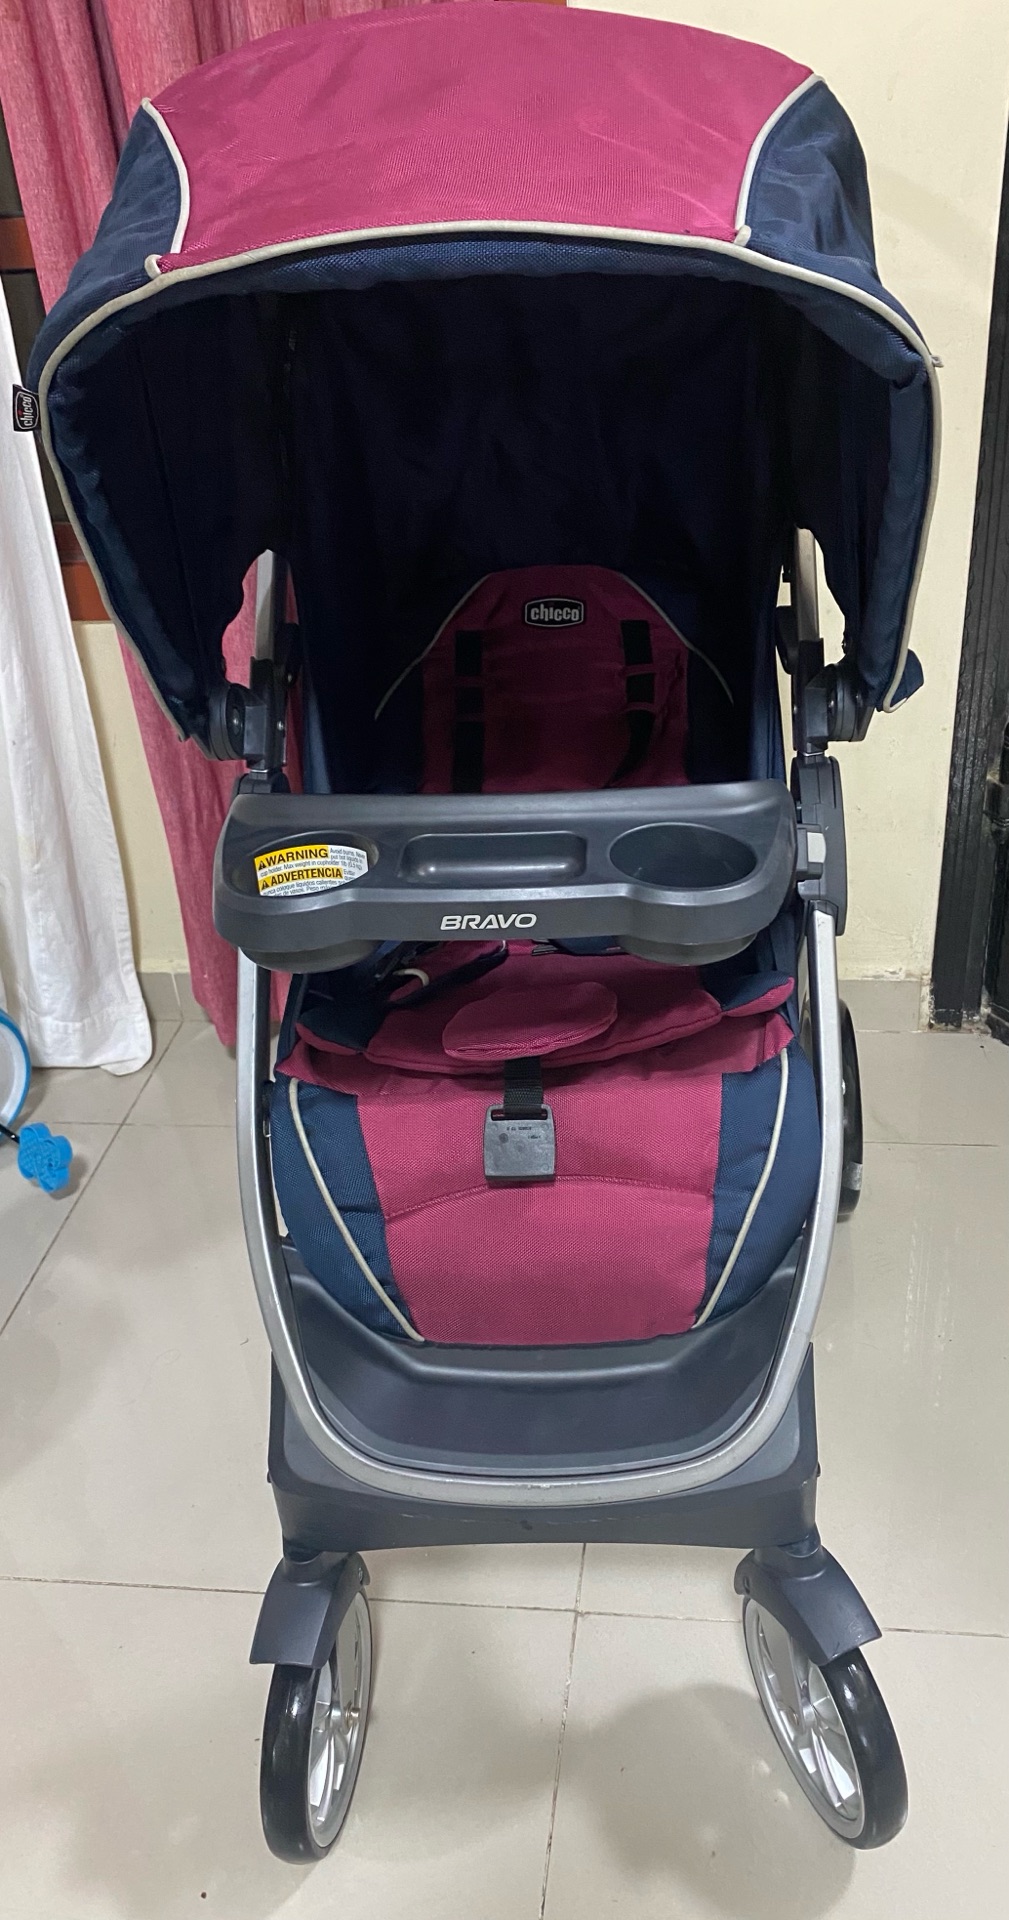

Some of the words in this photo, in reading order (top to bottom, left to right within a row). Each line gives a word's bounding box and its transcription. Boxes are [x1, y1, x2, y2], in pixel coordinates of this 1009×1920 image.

[20, 396, 34, 426] chicco
[530, 603, 580, 622] chicco
[265, 848, 328, 866] WARNING
[294, 860, 310, 868] weight
[316, 859, 340, 867] cupholder
[271, 867, 343, 887] ADVERTENCIA
[440, 913, 537, 931] BRAVO
